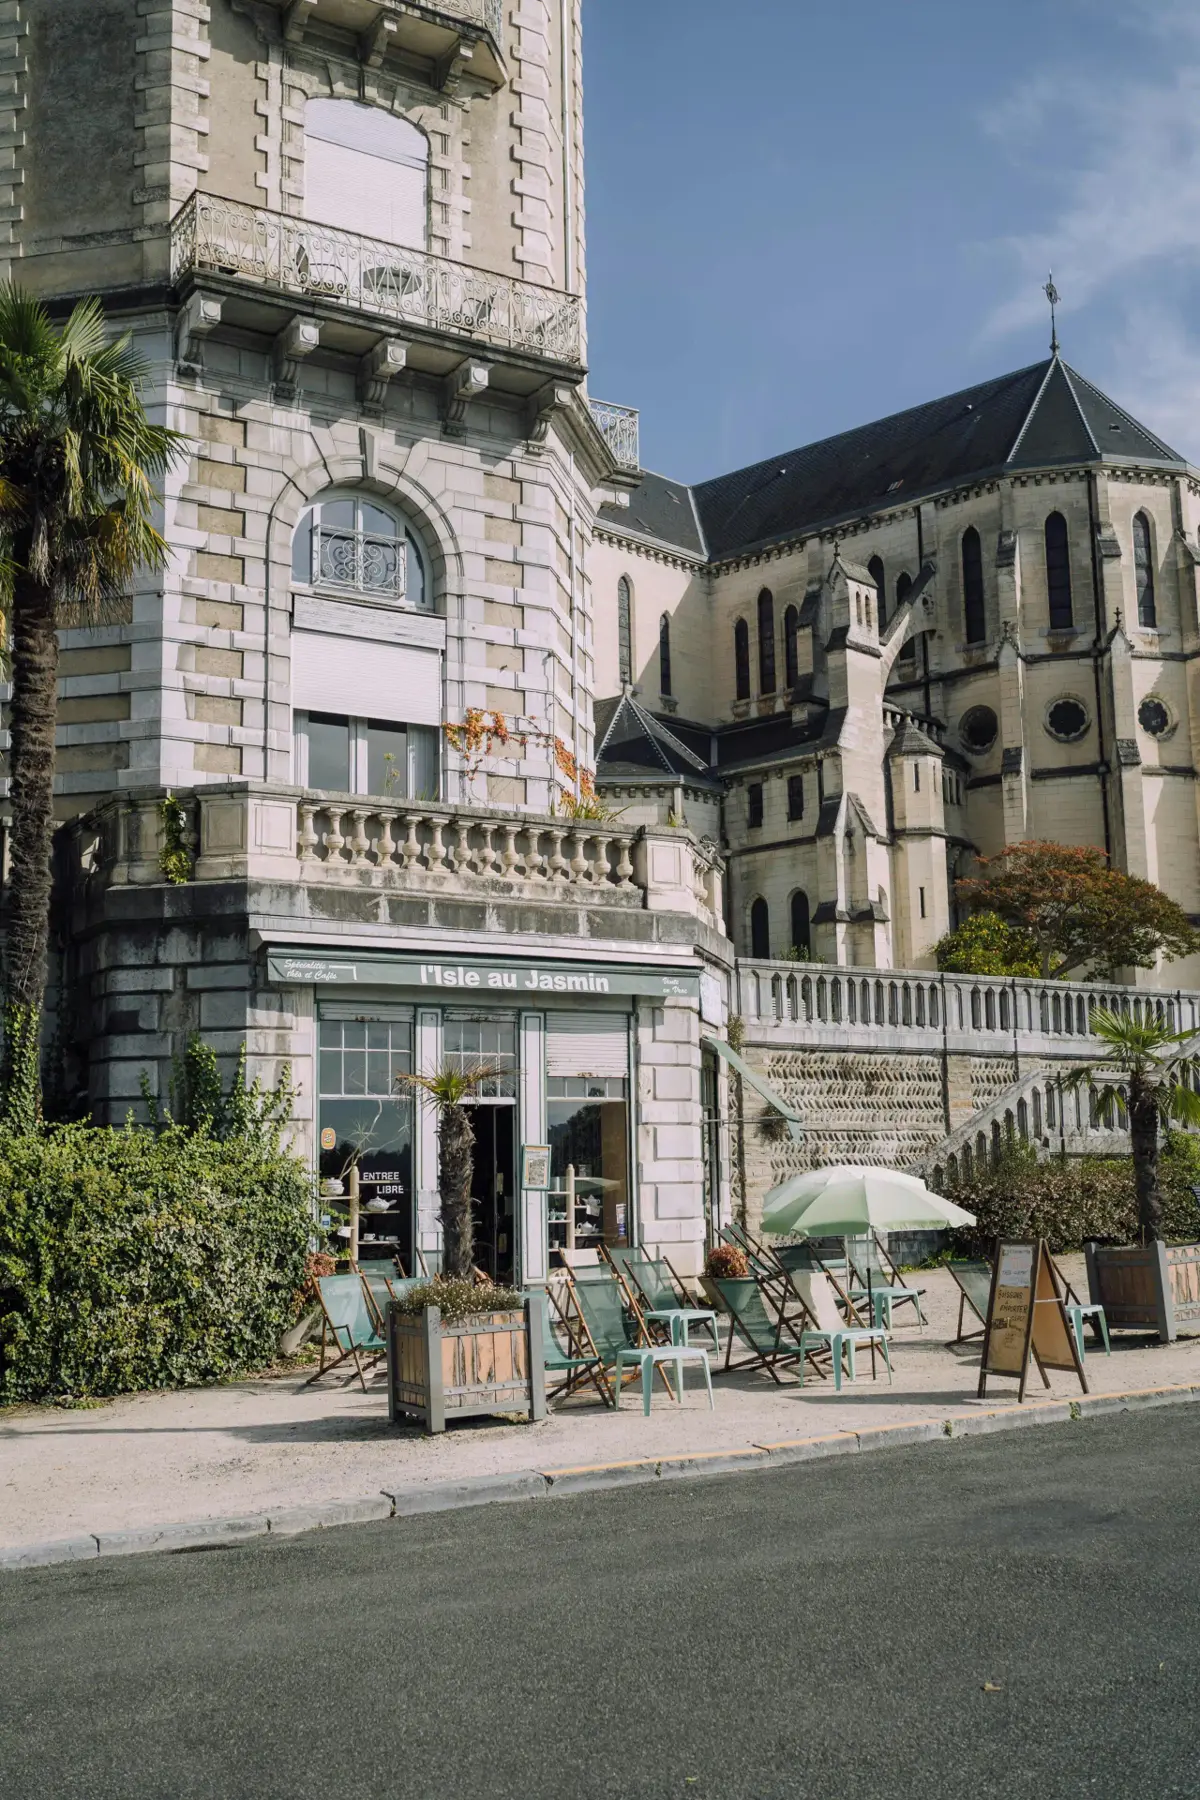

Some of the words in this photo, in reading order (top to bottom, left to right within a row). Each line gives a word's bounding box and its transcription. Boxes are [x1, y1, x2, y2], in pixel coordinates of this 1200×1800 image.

[304, 971, 313, 979] et
[420, 965, 481, 987] l'Isle
[487, 972, 518, 988] au
[524, 970, 610, 992] Jasmin
[362, 1171, 400, 1181] ENTREE
[376, 1185, 405, 1194] LIBRE
